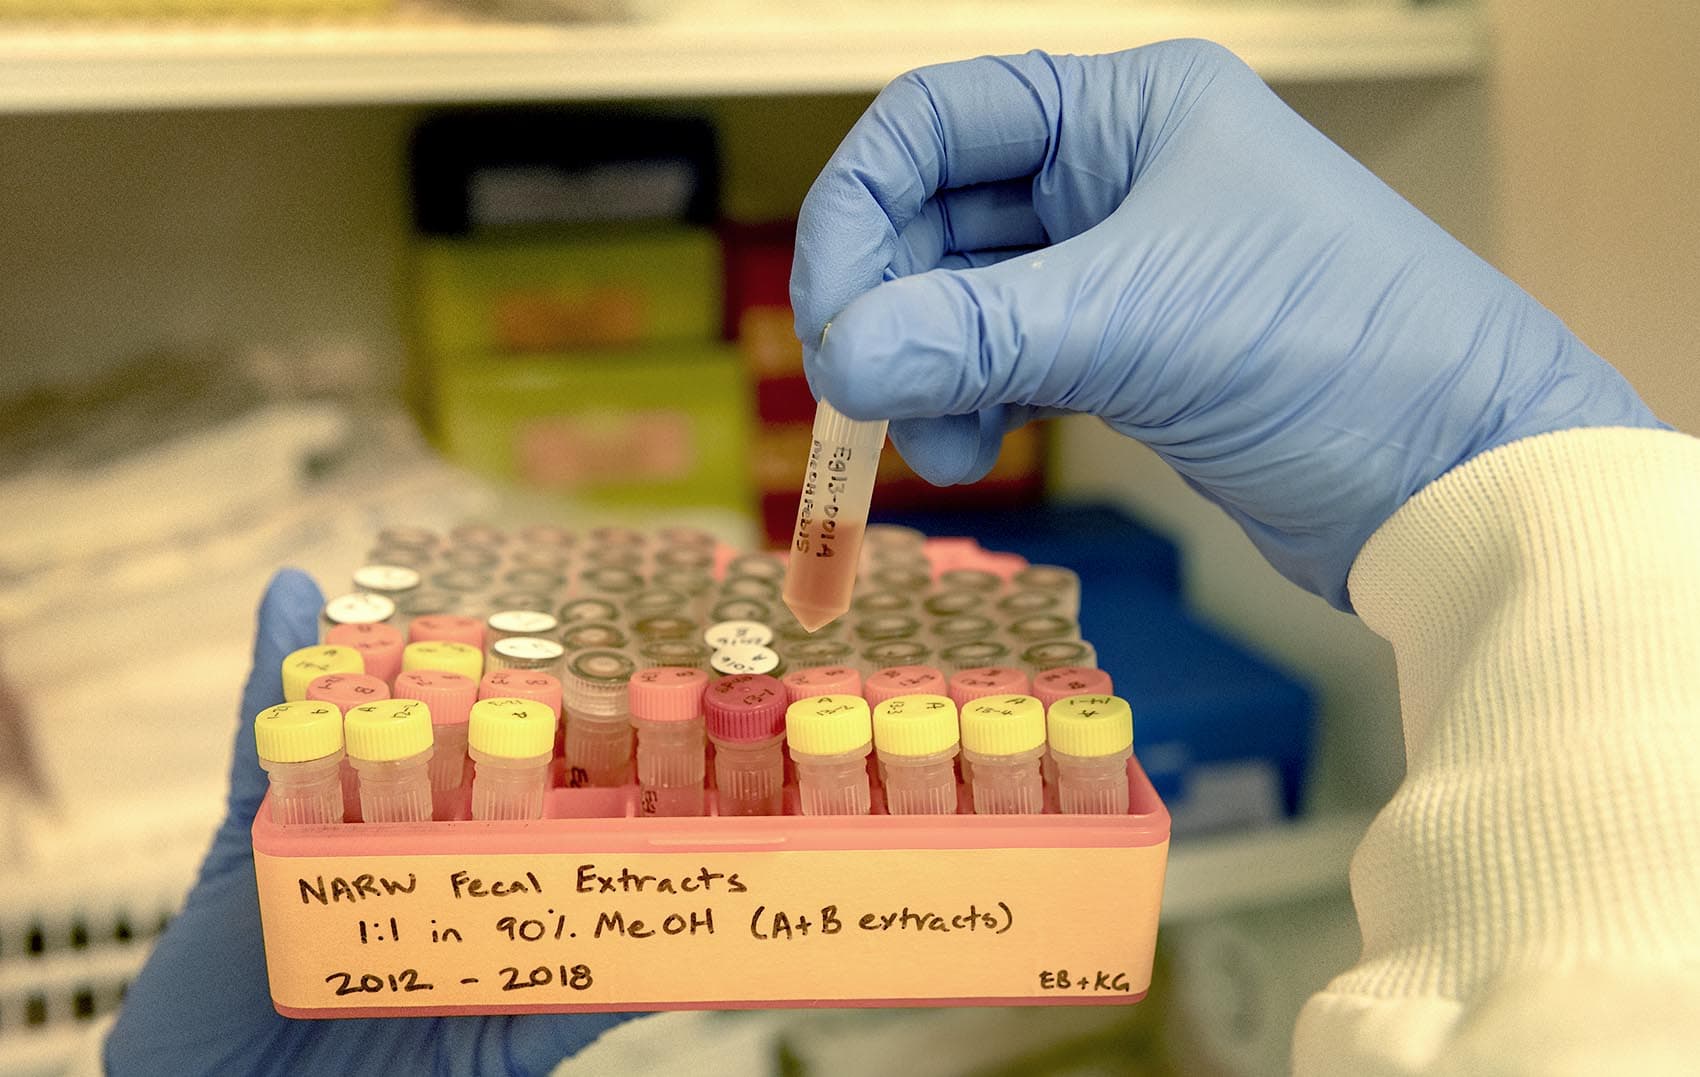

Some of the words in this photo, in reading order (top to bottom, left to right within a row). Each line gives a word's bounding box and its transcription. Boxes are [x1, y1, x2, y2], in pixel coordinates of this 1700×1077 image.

[298, 873, 417, 906] NARW
[451, 870, 542, 899] Fecal
[576, 864, 748, 893] Extracts
[358, 917, 399, 944] 1:1
[431, 919, 463, 943] in
[857, 902, 1013, 936] extracts)
[325, 968, 434, 997] 2012
[498, 964, 594, 992] 2018
